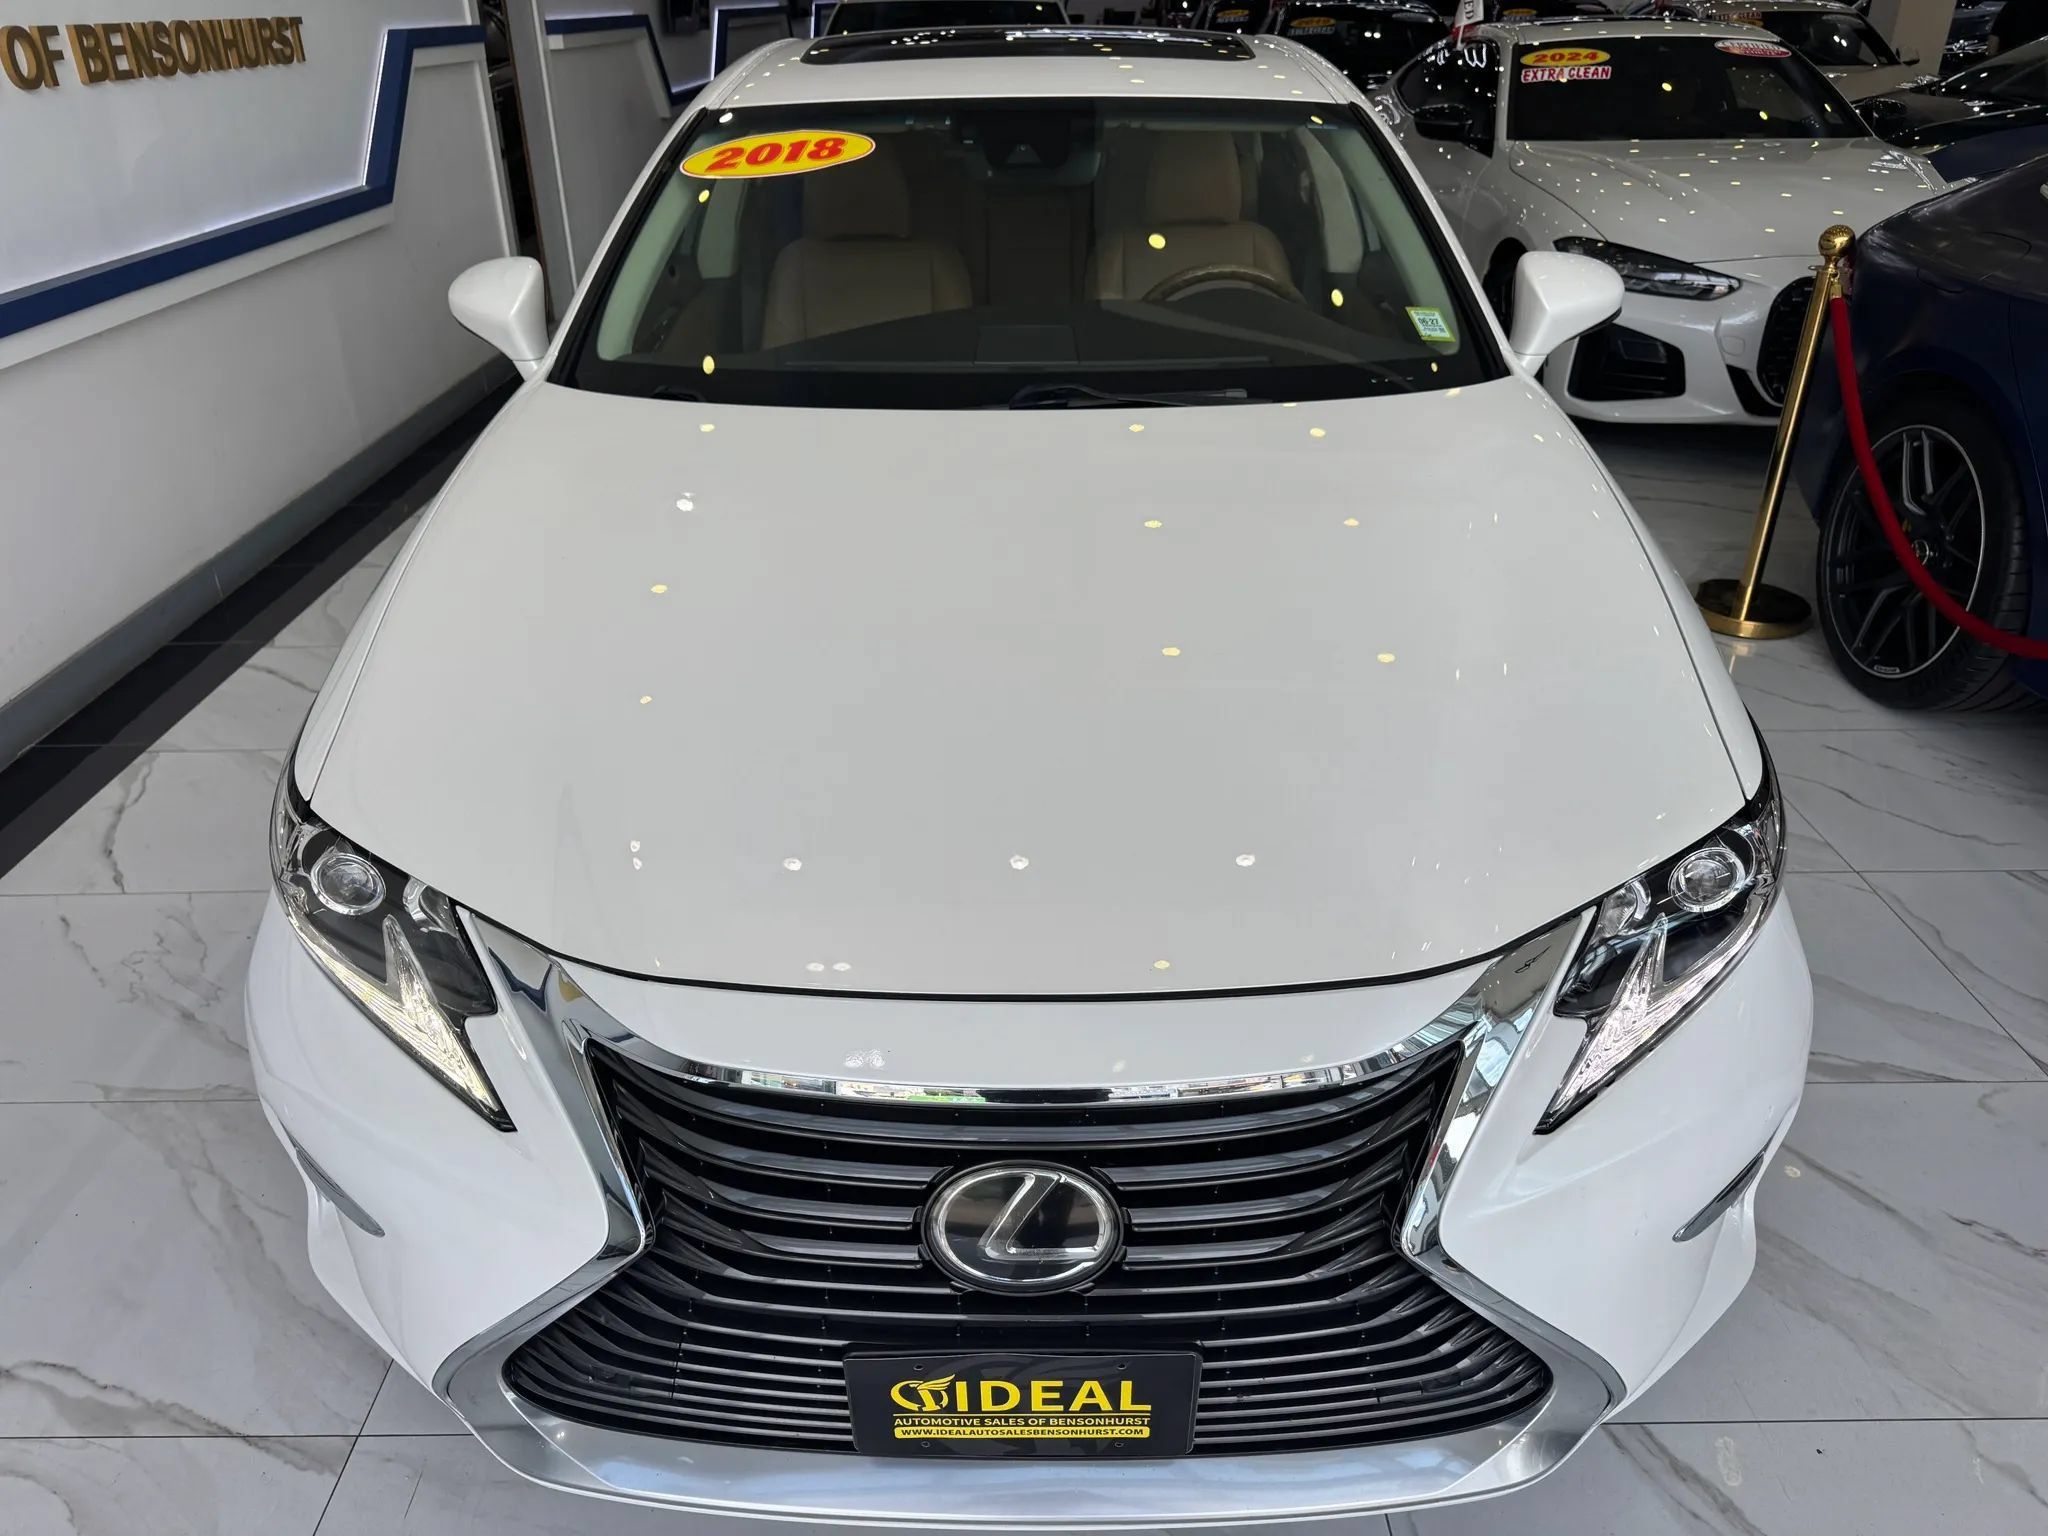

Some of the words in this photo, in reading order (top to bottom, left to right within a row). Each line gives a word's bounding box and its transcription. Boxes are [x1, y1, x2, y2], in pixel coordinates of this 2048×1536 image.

[0, 25, 65, 91] OF
[65, 17, 306, 85] BENSONHURST
[1533, 52, 1599, 64] 2024
[1523, 68, 1565, 82] EXTRA
[1568, 66, 1610, 79] CLEAN
[705, 137, 848, 172] 2018
[955, 1380, 1152, 1412] IDEAL
[894, 1418, 981, 1426] AUTOMOTIVE
[984, 1418, 1025, 1426] SALES
[1028, 1418, 1047, 1426] OF
[1049, 1417, 1151, 1426] BENSONHURST
[901, 1428, 1144, 1436] WWW.IDEALAUTOSALESBENSONHURST.COM
